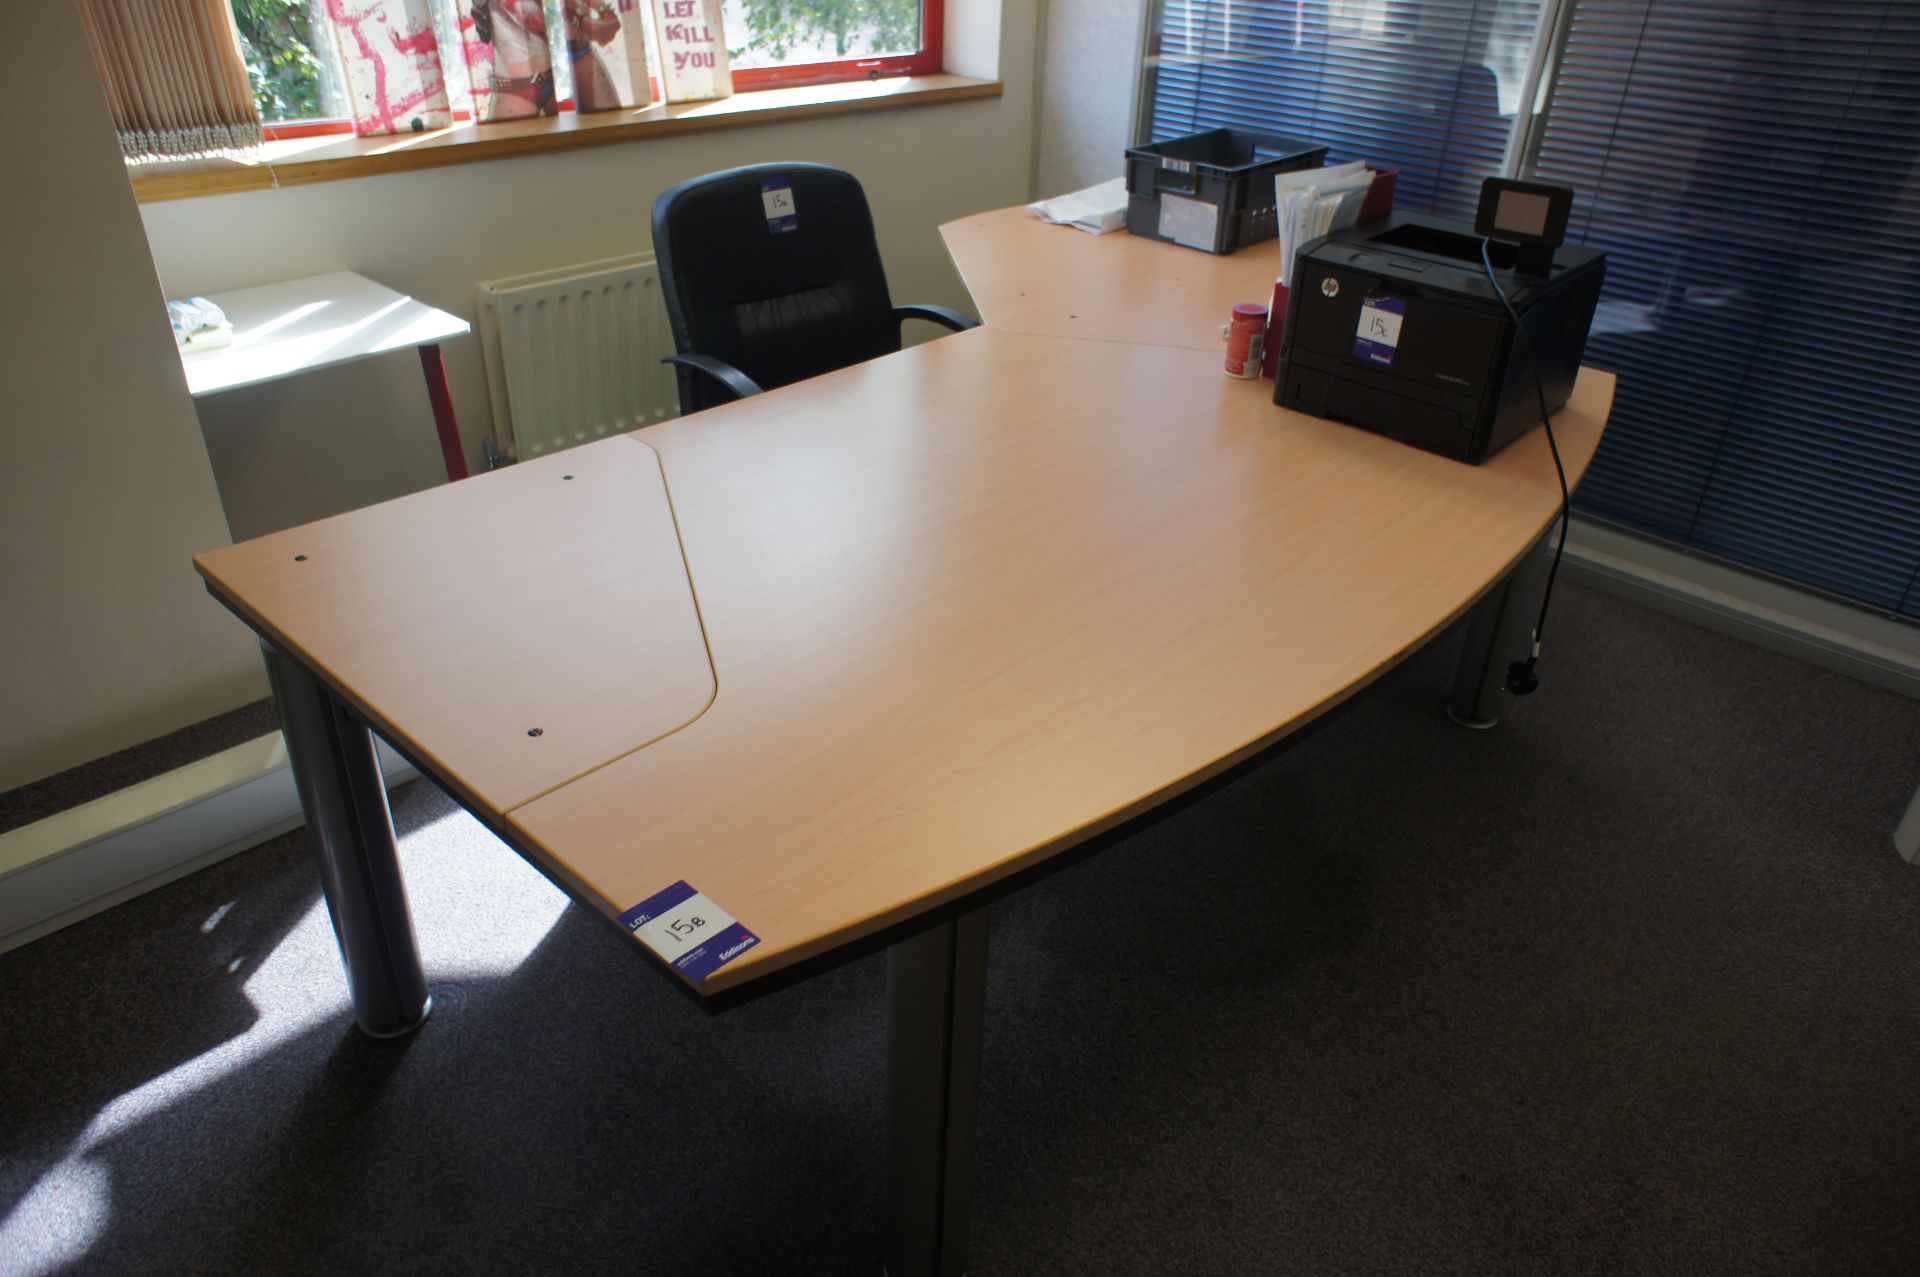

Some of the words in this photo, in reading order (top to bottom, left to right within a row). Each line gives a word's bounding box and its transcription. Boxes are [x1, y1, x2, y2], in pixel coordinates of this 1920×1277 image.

[663, 0, 696, 18] LET
[665, 24, 715, 43] KILL
[674, 51, 715, 70] YOU
[1322, 277, 1338, 297] hp
